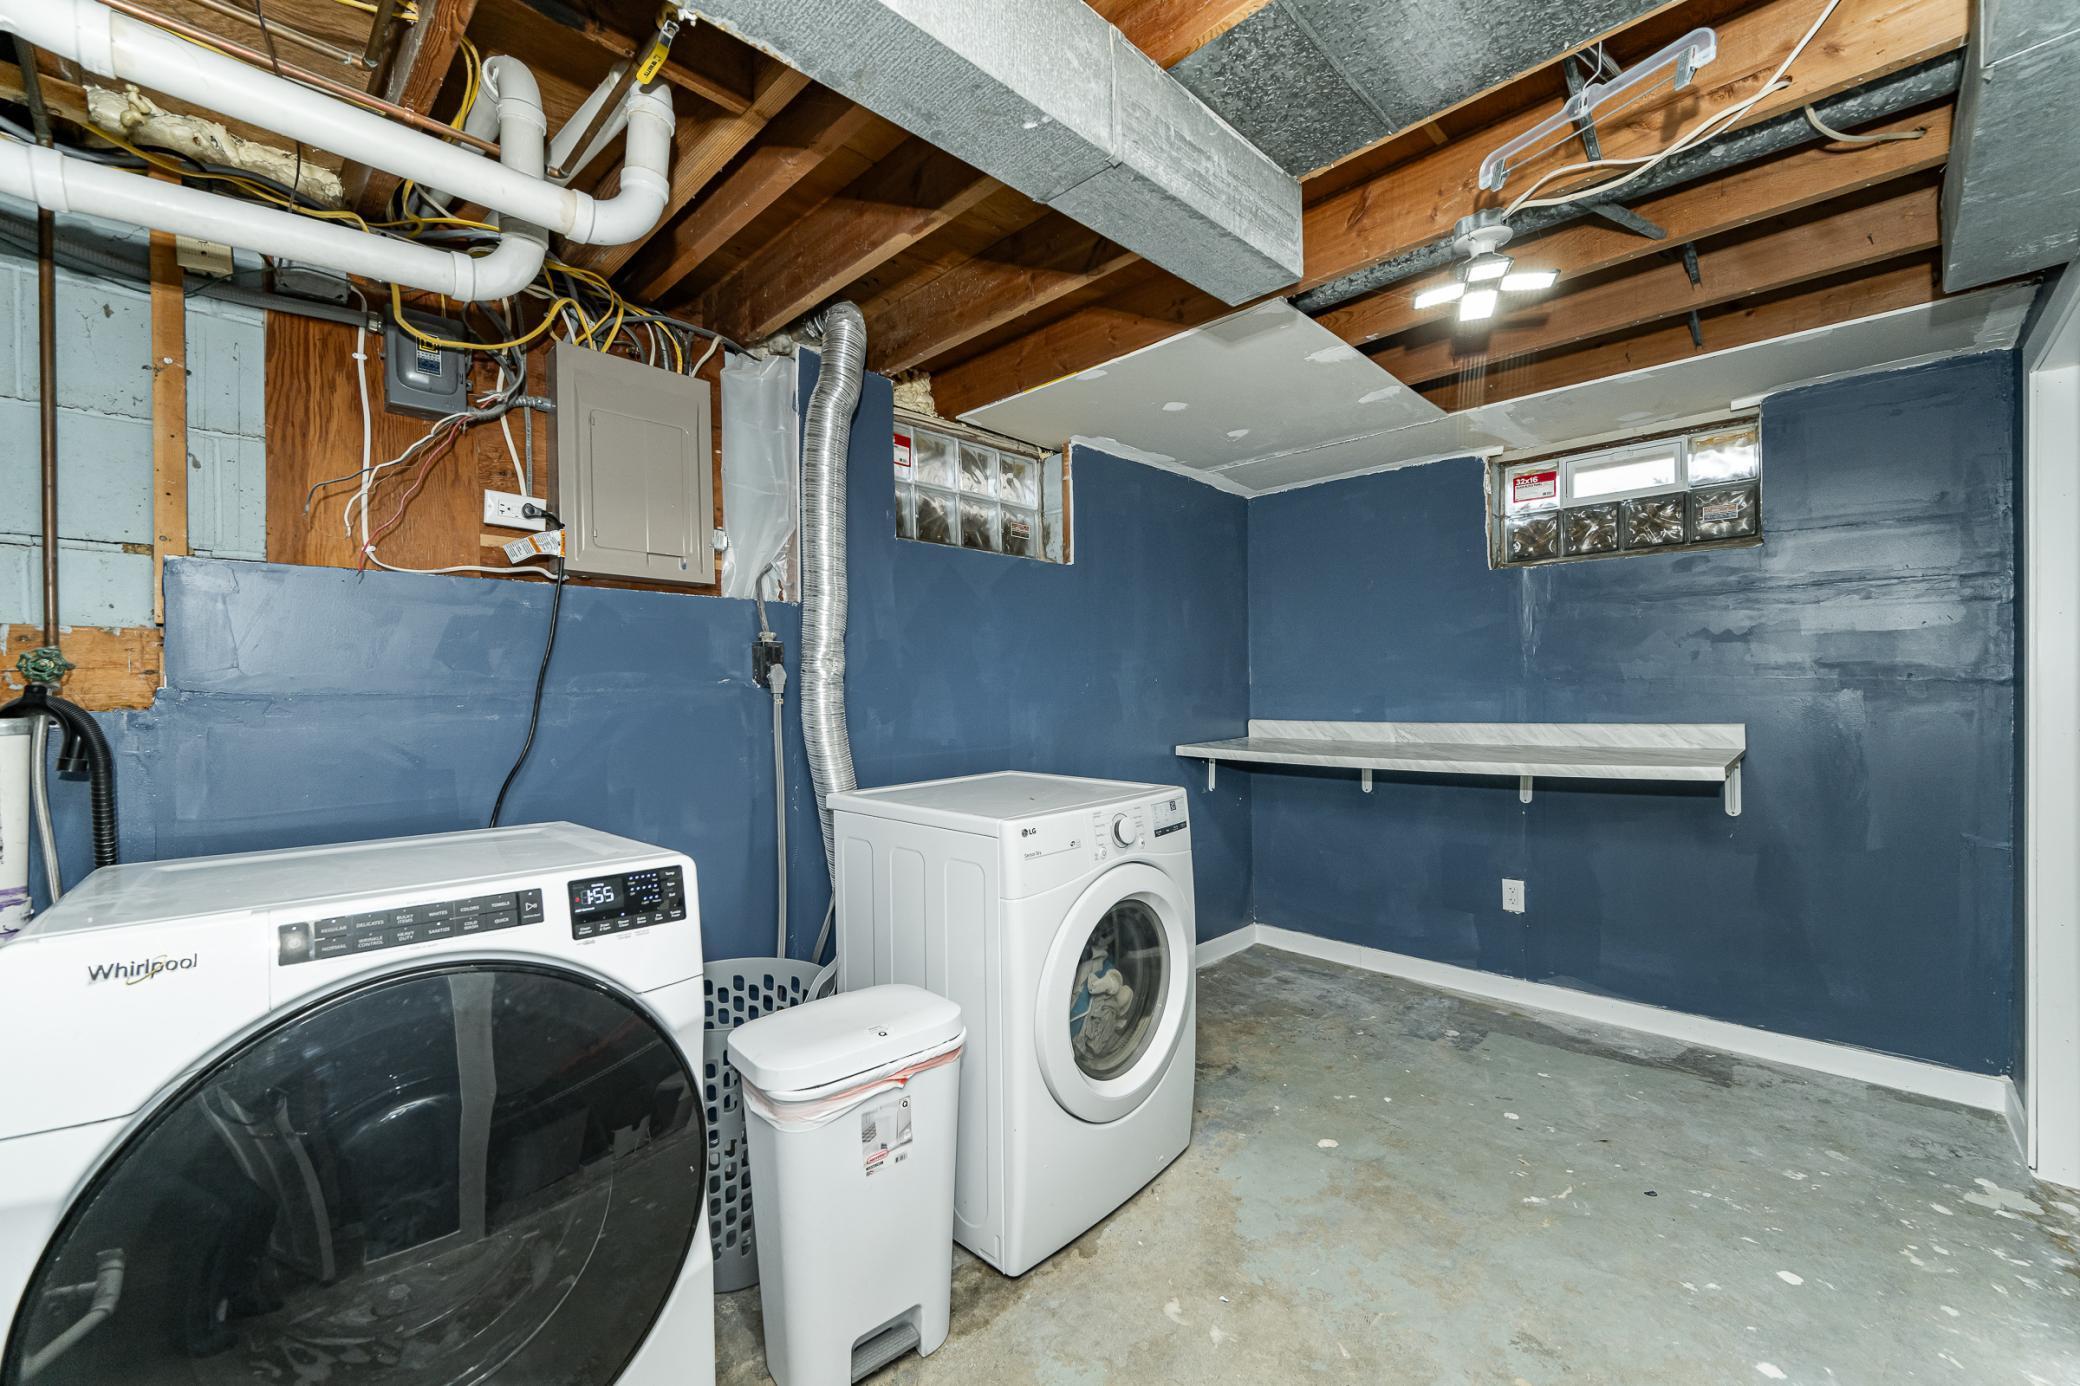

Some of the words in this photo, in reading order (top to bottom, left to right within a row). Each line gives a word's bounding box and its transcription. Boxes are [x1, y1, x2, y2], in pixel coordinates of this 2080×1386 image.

[1516, 476, 1538, 486] 32x16
[356, 920, 384, 928] DELICATES
[88, 953, 198, 981] Whirlpool
